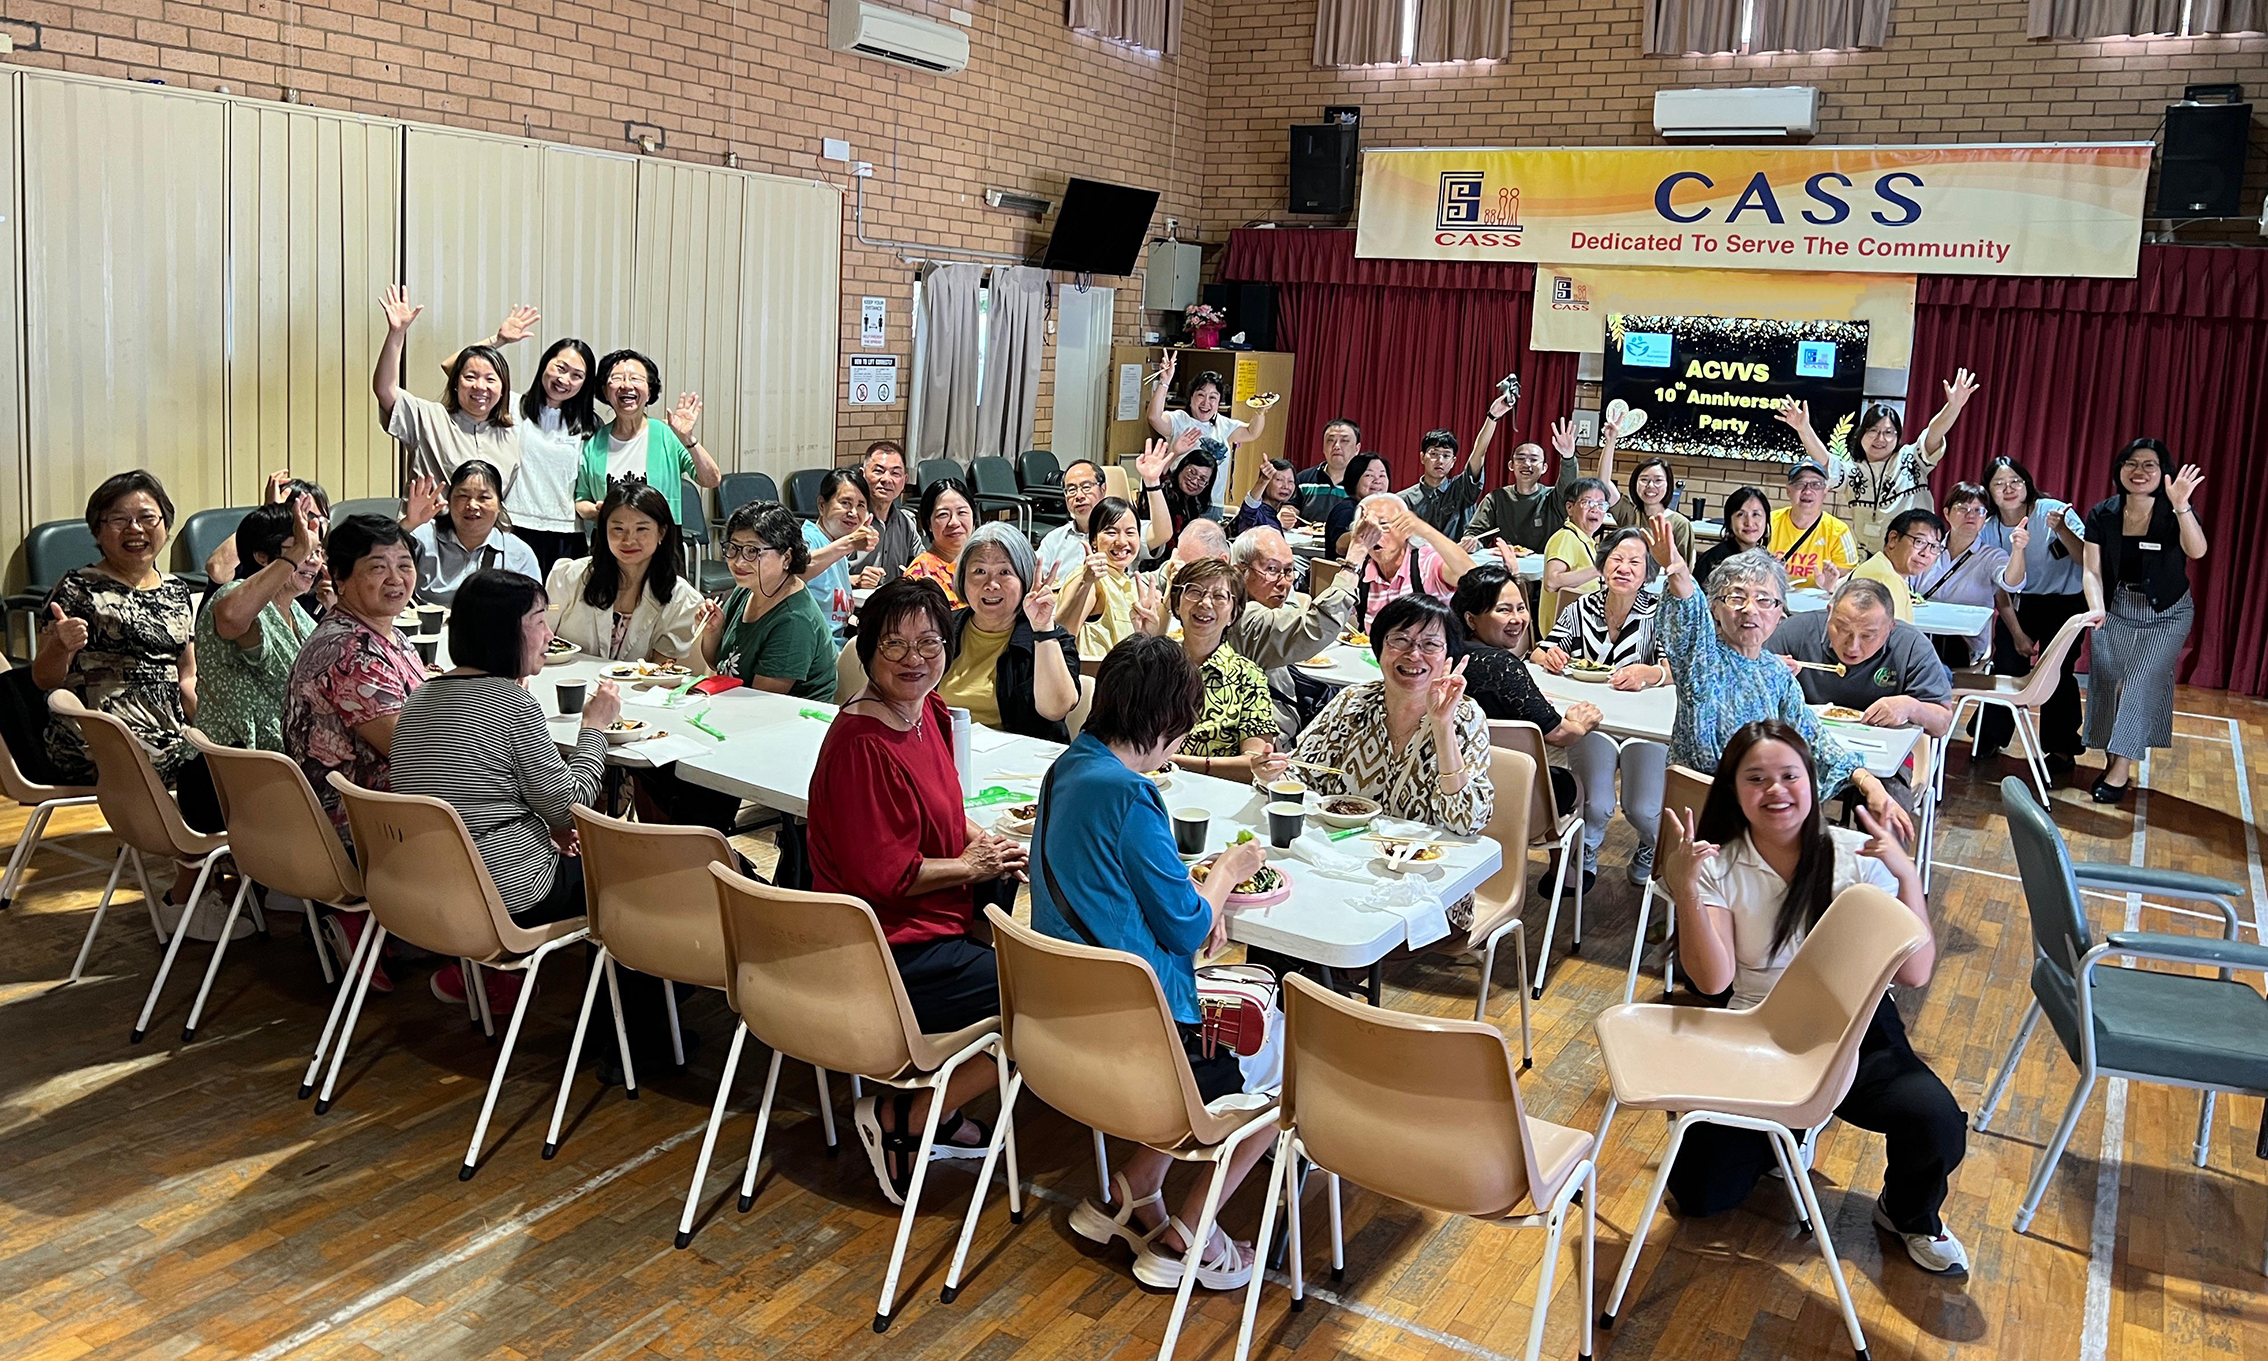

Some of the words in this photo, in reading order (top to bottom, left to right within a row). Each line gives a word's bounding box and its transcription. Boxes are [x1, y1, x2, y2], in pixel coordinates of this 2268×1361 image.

[1653, 171, 1926, 227] CASS
[1434, 232, 1522, 248] CASS
[1571, 231, 1683, 251] Dedicated
[1691, 233, 1719, 253] To
[1725, 234, 1796, 255] Serve
[1803, 236, 1850, 256] The
[1857, 237, 2011, 264] Community
[1551, 303, 1589, 311] CASS
[1685, 359, 1770, 383] ACVVS
[1699, 414, 1750, 435] Party
